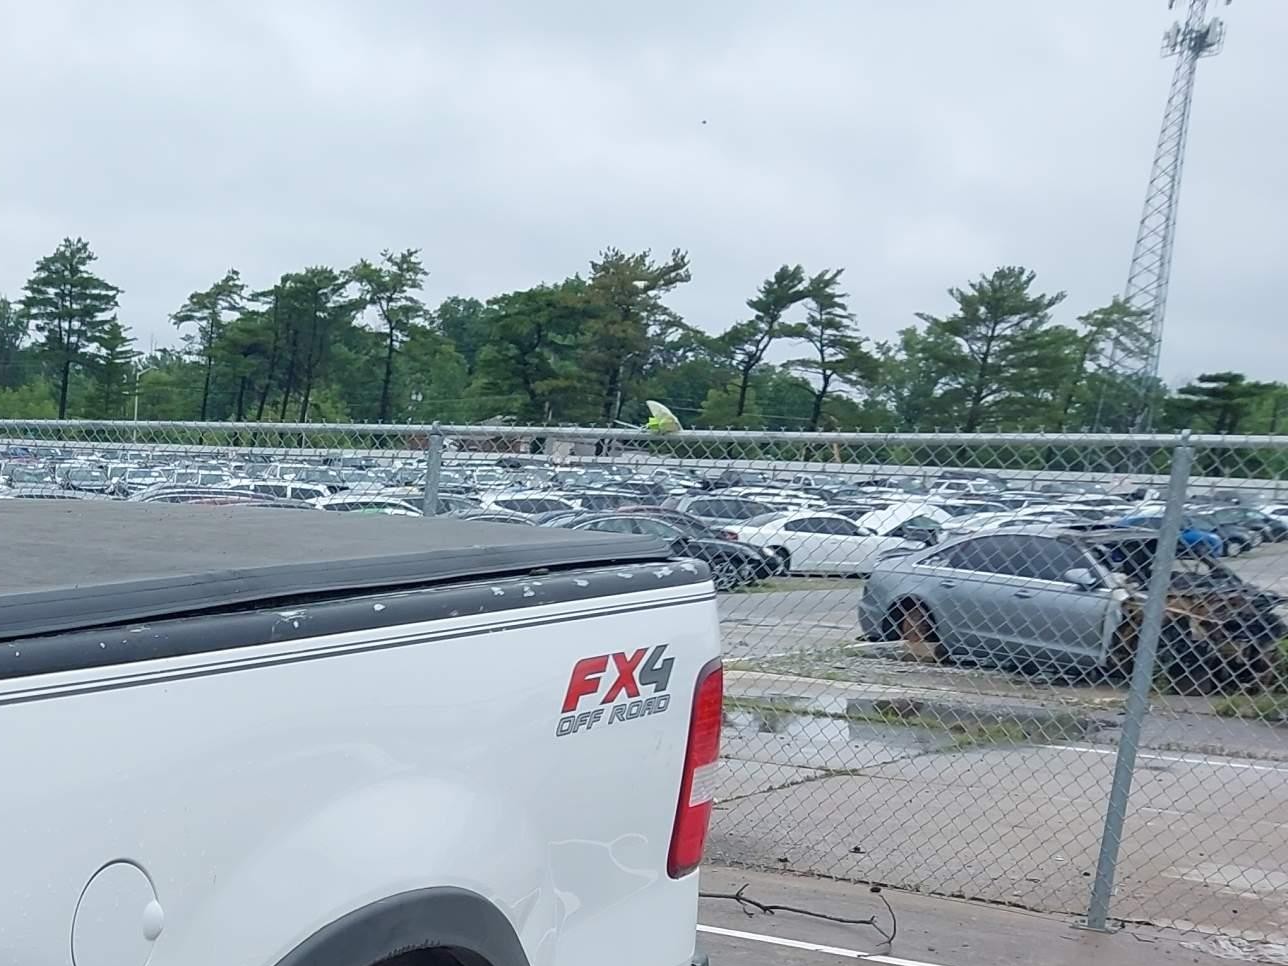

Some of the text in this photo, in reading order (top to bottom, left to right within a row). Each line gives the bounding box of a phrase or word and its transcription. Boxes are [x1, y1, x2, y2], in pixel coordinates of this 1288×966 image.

[561, 643, 675, 714] FX4
[556, 694, 671, 737] OFF ROAD
